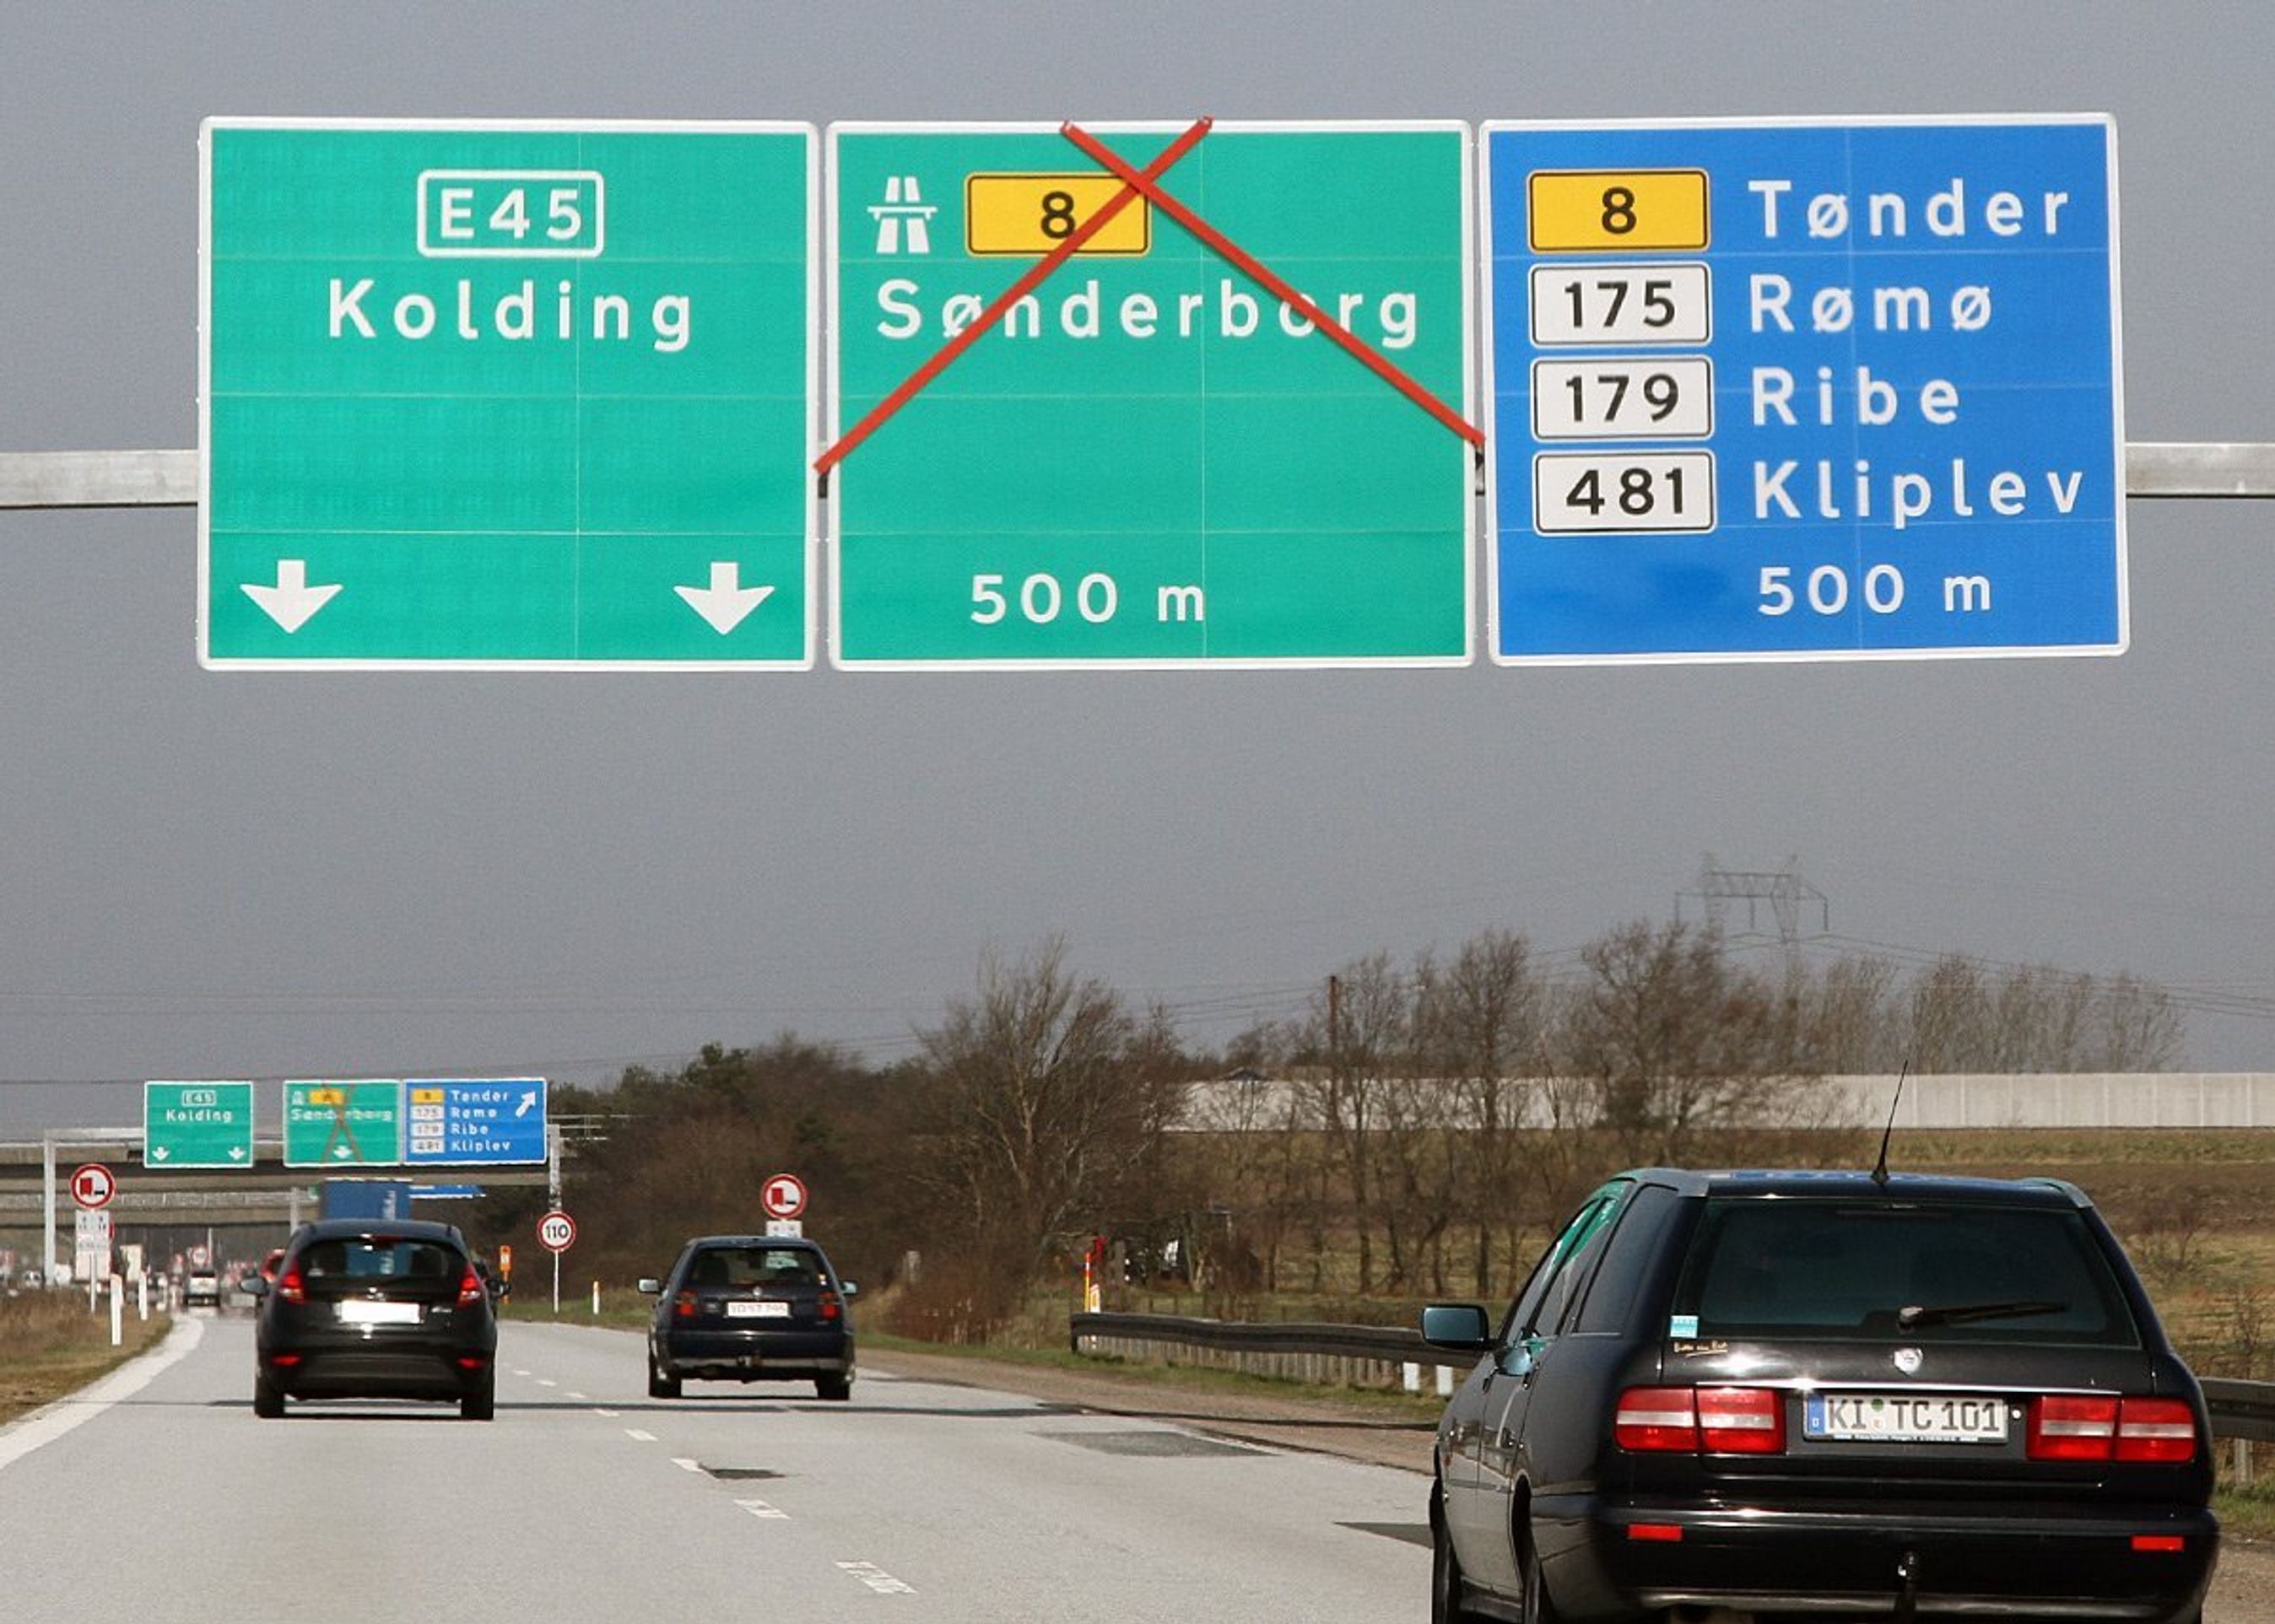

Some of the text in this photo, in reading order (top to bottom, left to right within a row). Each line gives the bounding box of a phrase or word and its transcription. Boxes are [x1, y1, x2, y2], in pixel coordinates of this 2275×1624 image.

[441, 188, 582, 240] E45
[1040, 191, 1077, 240] 8
[1601, 187, 1637, 234] 8
[1748, 178, 2069, 239] Tønder
[329, 278, 691, 352] Kolding
[876, 278, 1417, 349] Sønderborg
[1564, 280, 1676, 328] 175
[1749, 273, 1991, 332] Rømø
[1564, 374, 1679, 422] 179
[1752, 366, 1959, 426] Ribe
[1565, 467, 1683, 515] 481
[1754, 458, 2083, 530] Kliplev
[970, 572, 1205, 624] 500 m
[1759, 564, 1991, 616] 500 m
[166, 1109, 232, 1124] Kolding
[451, 1122, 489, 1135] Ribe
[451, 1139, 511, 1153] Kliplev
[545, 1223, 570, 1239] 110
[1827, 1399, 2000, 1432] KI TC 101
